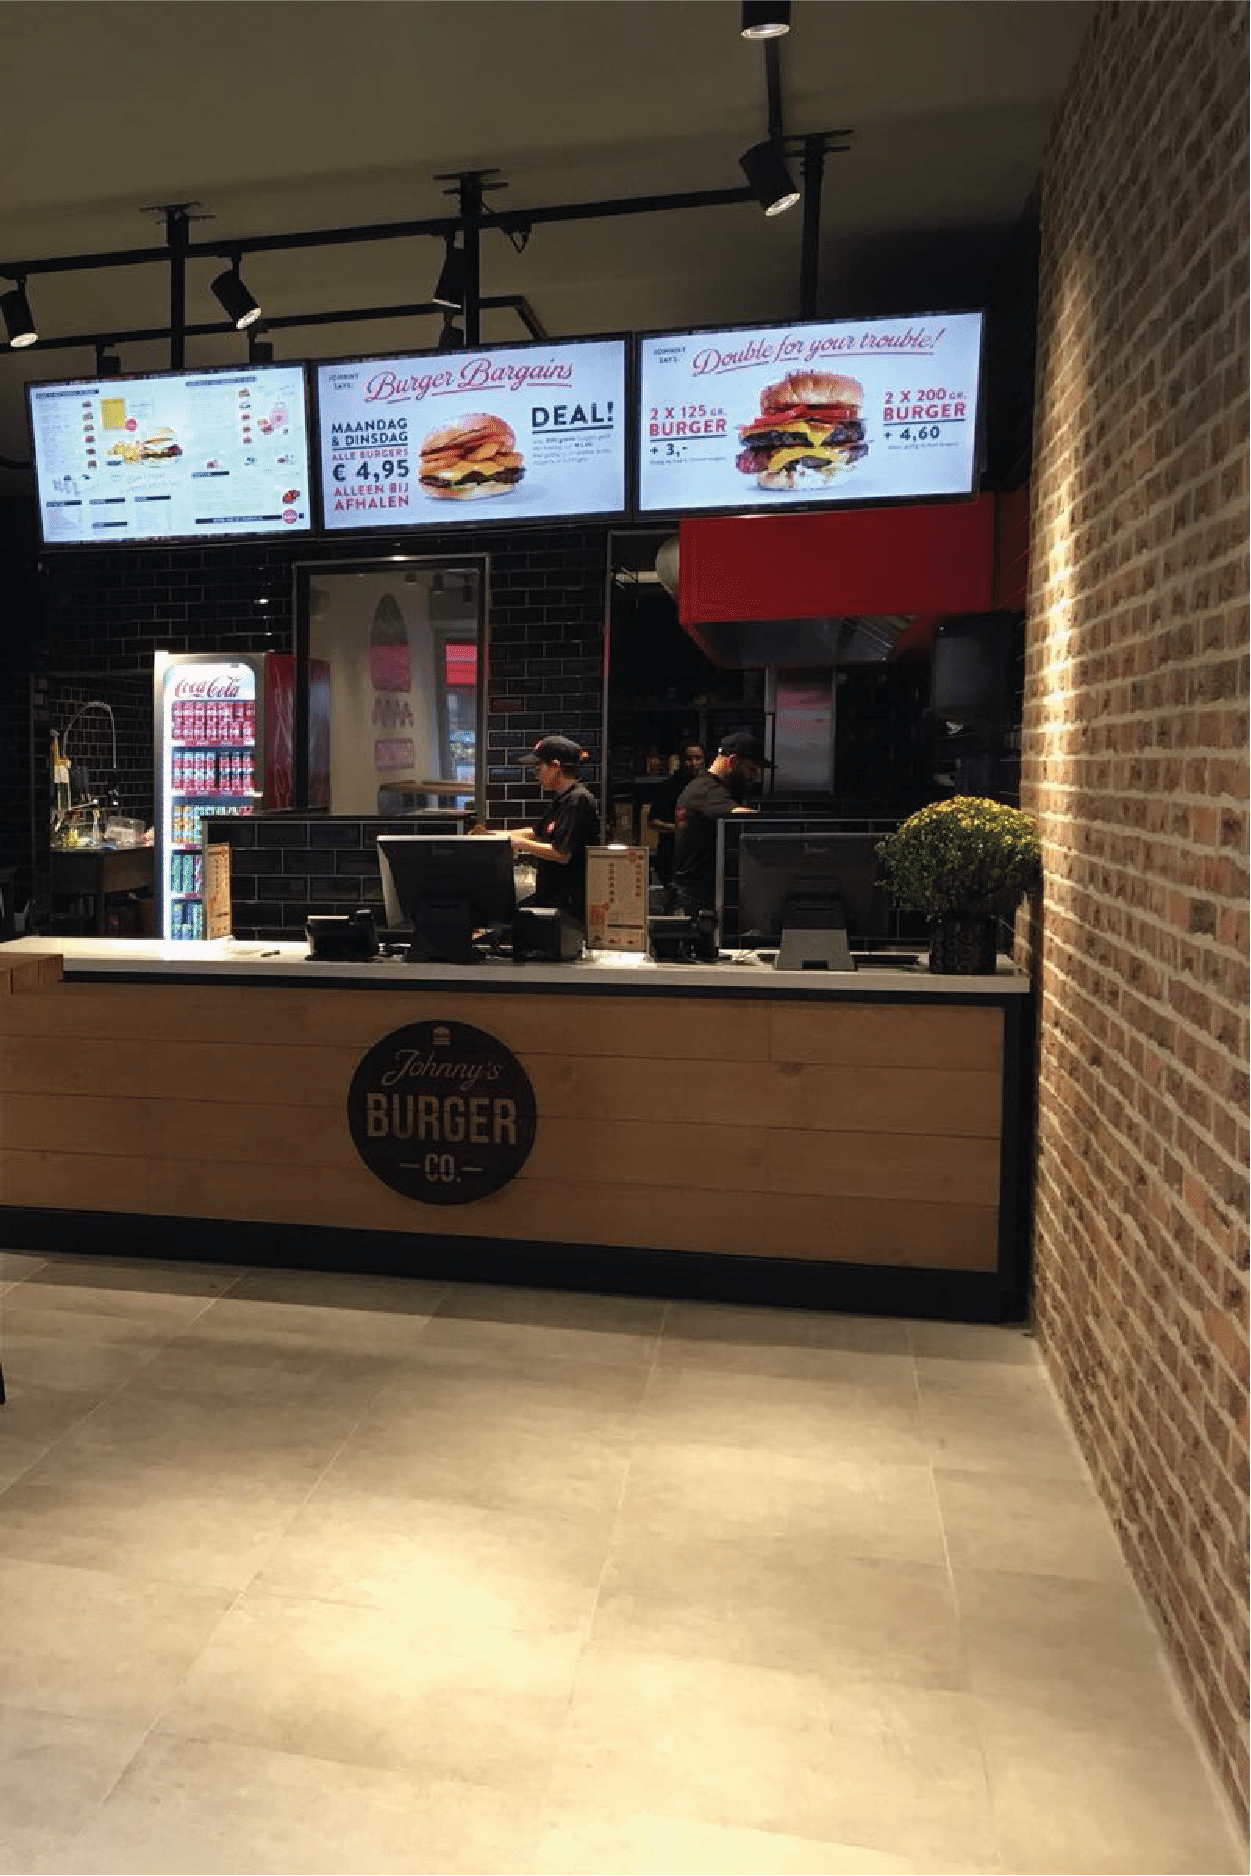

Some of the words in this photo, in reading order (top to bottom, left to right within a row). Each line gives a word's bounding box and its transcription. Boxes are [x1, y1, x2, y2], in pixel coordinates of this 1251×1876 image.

[691, 338, 772, 377] Double
[772, 334, 805, 363] for
[804, 334, 855, 362] your
[859, 327, 947, 349] trouble!
[364, 370, 454, 402] Burger
[457, 357, 573, 391] Bargains
[531, 401, 614, 428] DEAL!
[883, 401, 966, 421] BURGER
[332, 418, 408, 434] MAANDAG
[649, 418, 727, 437] BURGER
[345, 432, 408, 446] DINSDAG
[332, 462, 347, 483] €
[356, 459, 410, 484] 4,95
[334, 495, 409, 511] AFHALEN
[381, 1048, 505, 1091] Johnny's
[365, 1092, 517, 1145] BURGER
